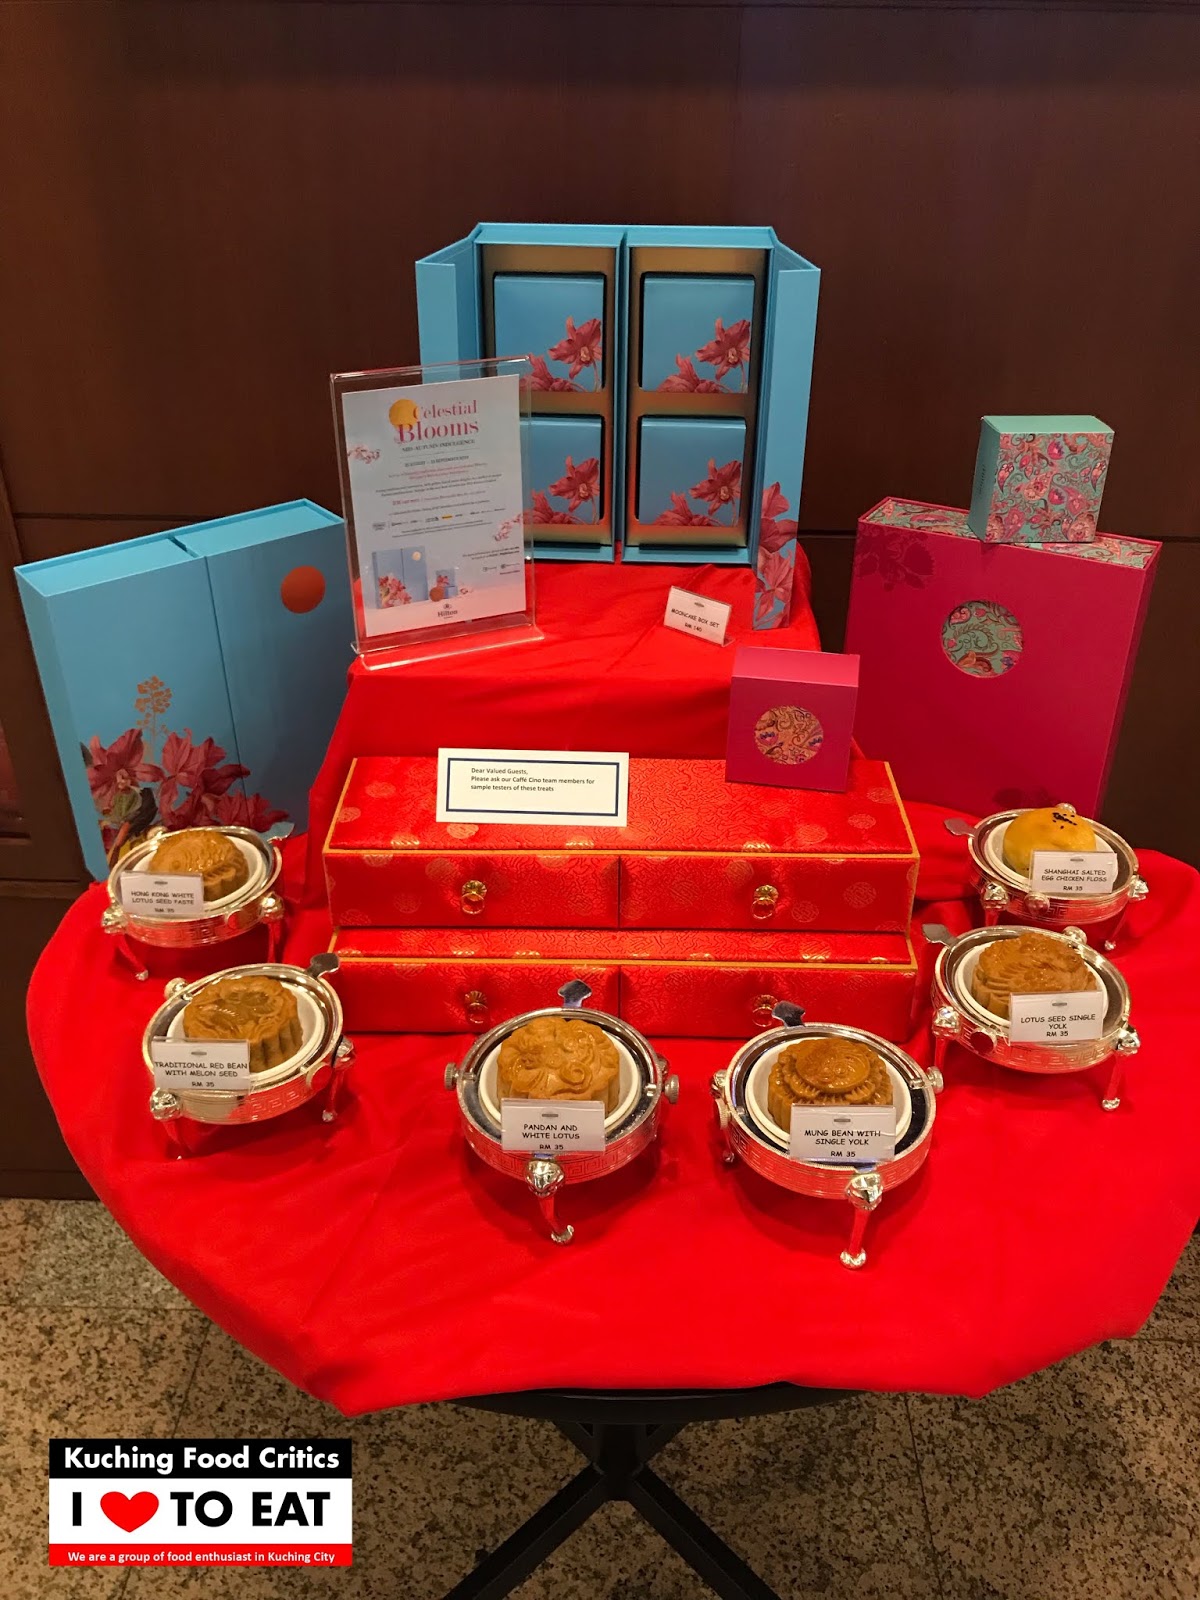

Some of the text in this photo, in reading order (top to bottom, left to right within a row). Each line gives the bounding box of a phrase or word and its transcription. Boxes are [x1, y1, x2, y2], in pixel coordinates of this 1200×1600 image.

[413, 400, 476, 419] Celestial
[394, 421, 479, 444] Blooms
[671, 608, 697, 621] MOONCAKE
[698, 617, 708, 625] BOX
[1048, 1015, 1067, 1023] SEED
[1069, 1013, 1096, 1021] SINGLE
[804, 1129, 829, 1137] MUNG
